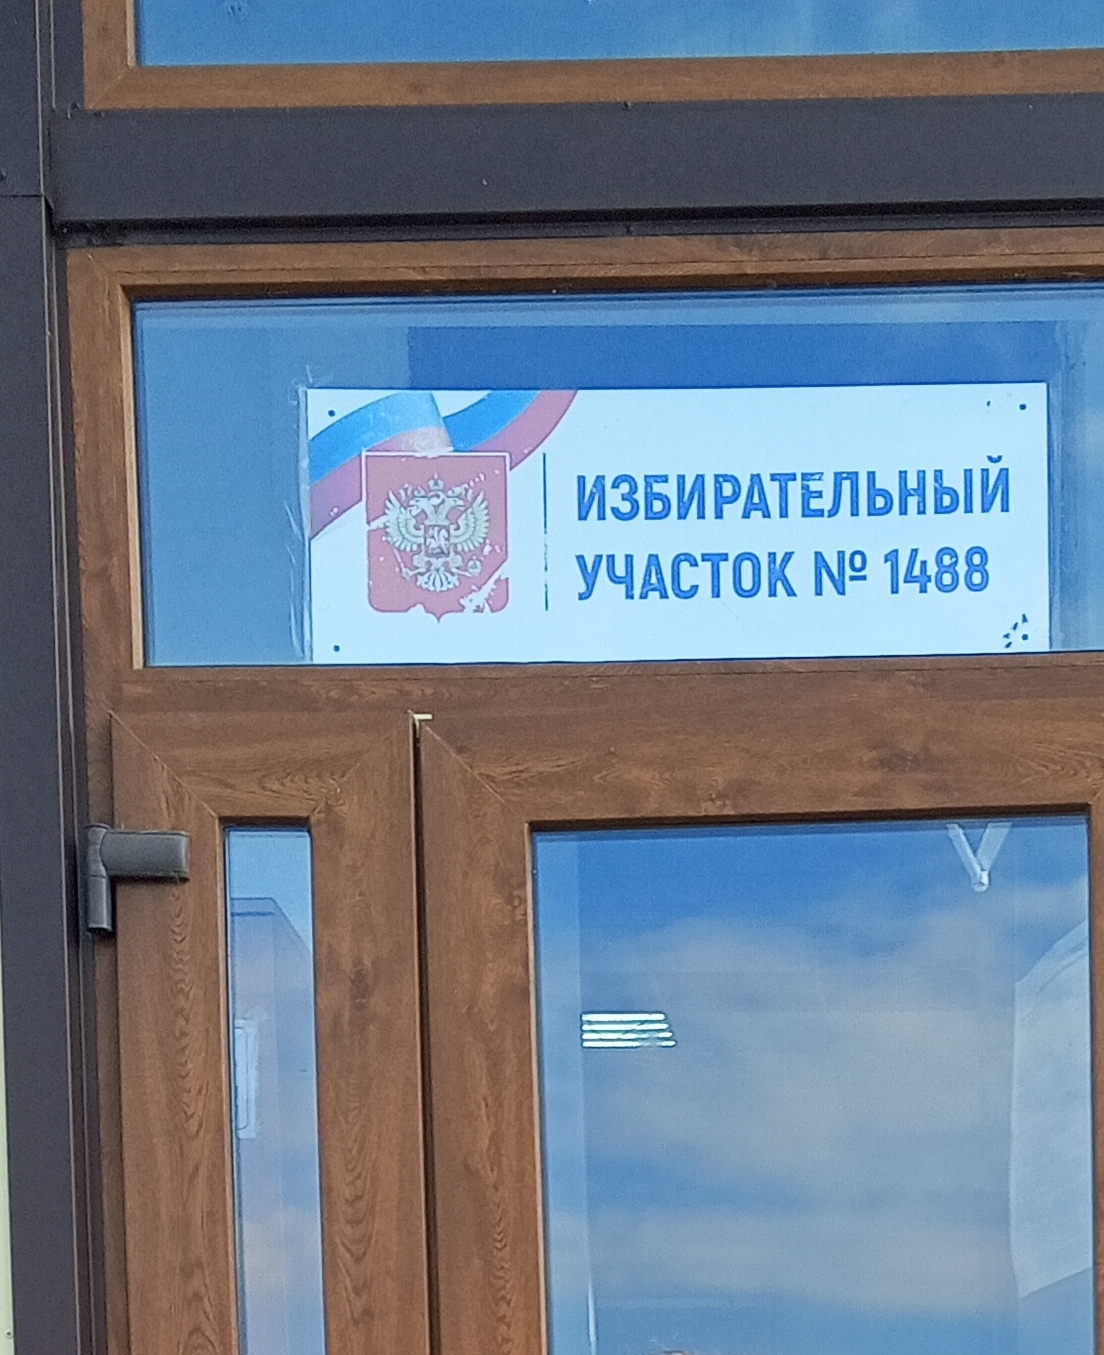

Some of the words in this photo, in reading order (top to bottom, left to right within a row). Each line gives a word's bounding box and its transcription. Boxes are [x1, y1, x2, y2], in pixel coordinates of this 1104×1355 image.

[576, 455, 1010, 522] ИЗБИРАТЕЛЬНЫЙ
[575, 549, 798, 601] УЧАСТОК
[813, 550, 868, 598] №
[883, 545, 991, 595] 1488
